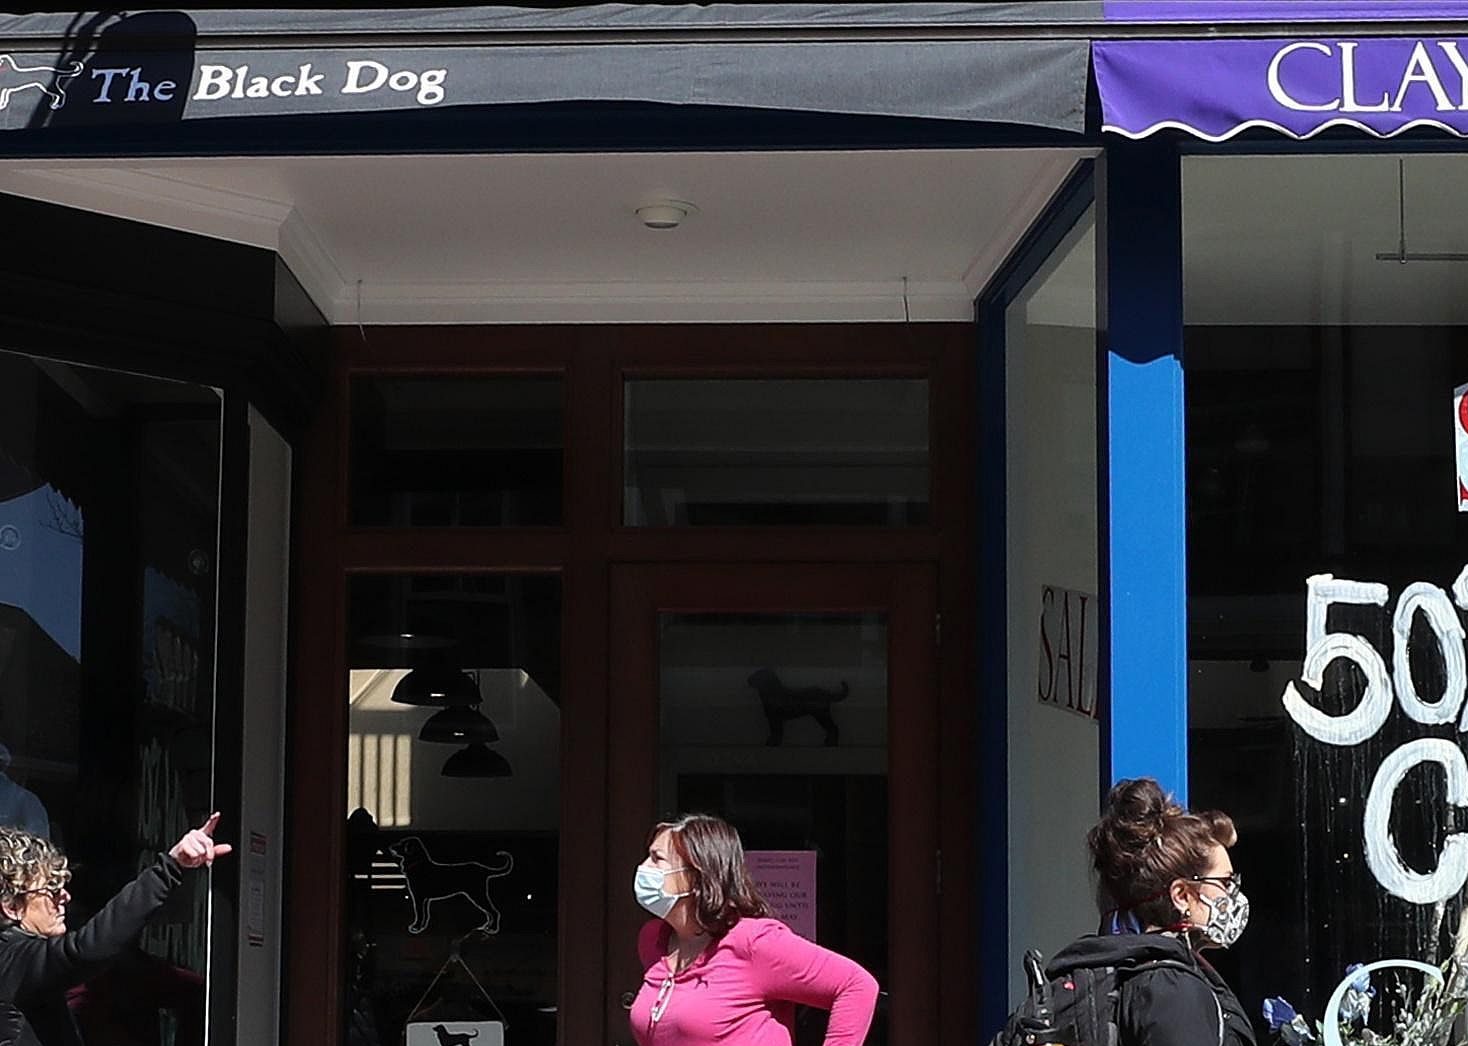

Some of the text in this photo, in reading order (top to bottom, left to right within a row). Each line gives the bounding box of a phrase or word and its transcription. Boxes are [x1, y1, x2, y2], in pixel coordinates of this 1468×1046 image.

[92, 61, 447, 104] The Black Dog
[1039, 587, 1099, 720] SAL
